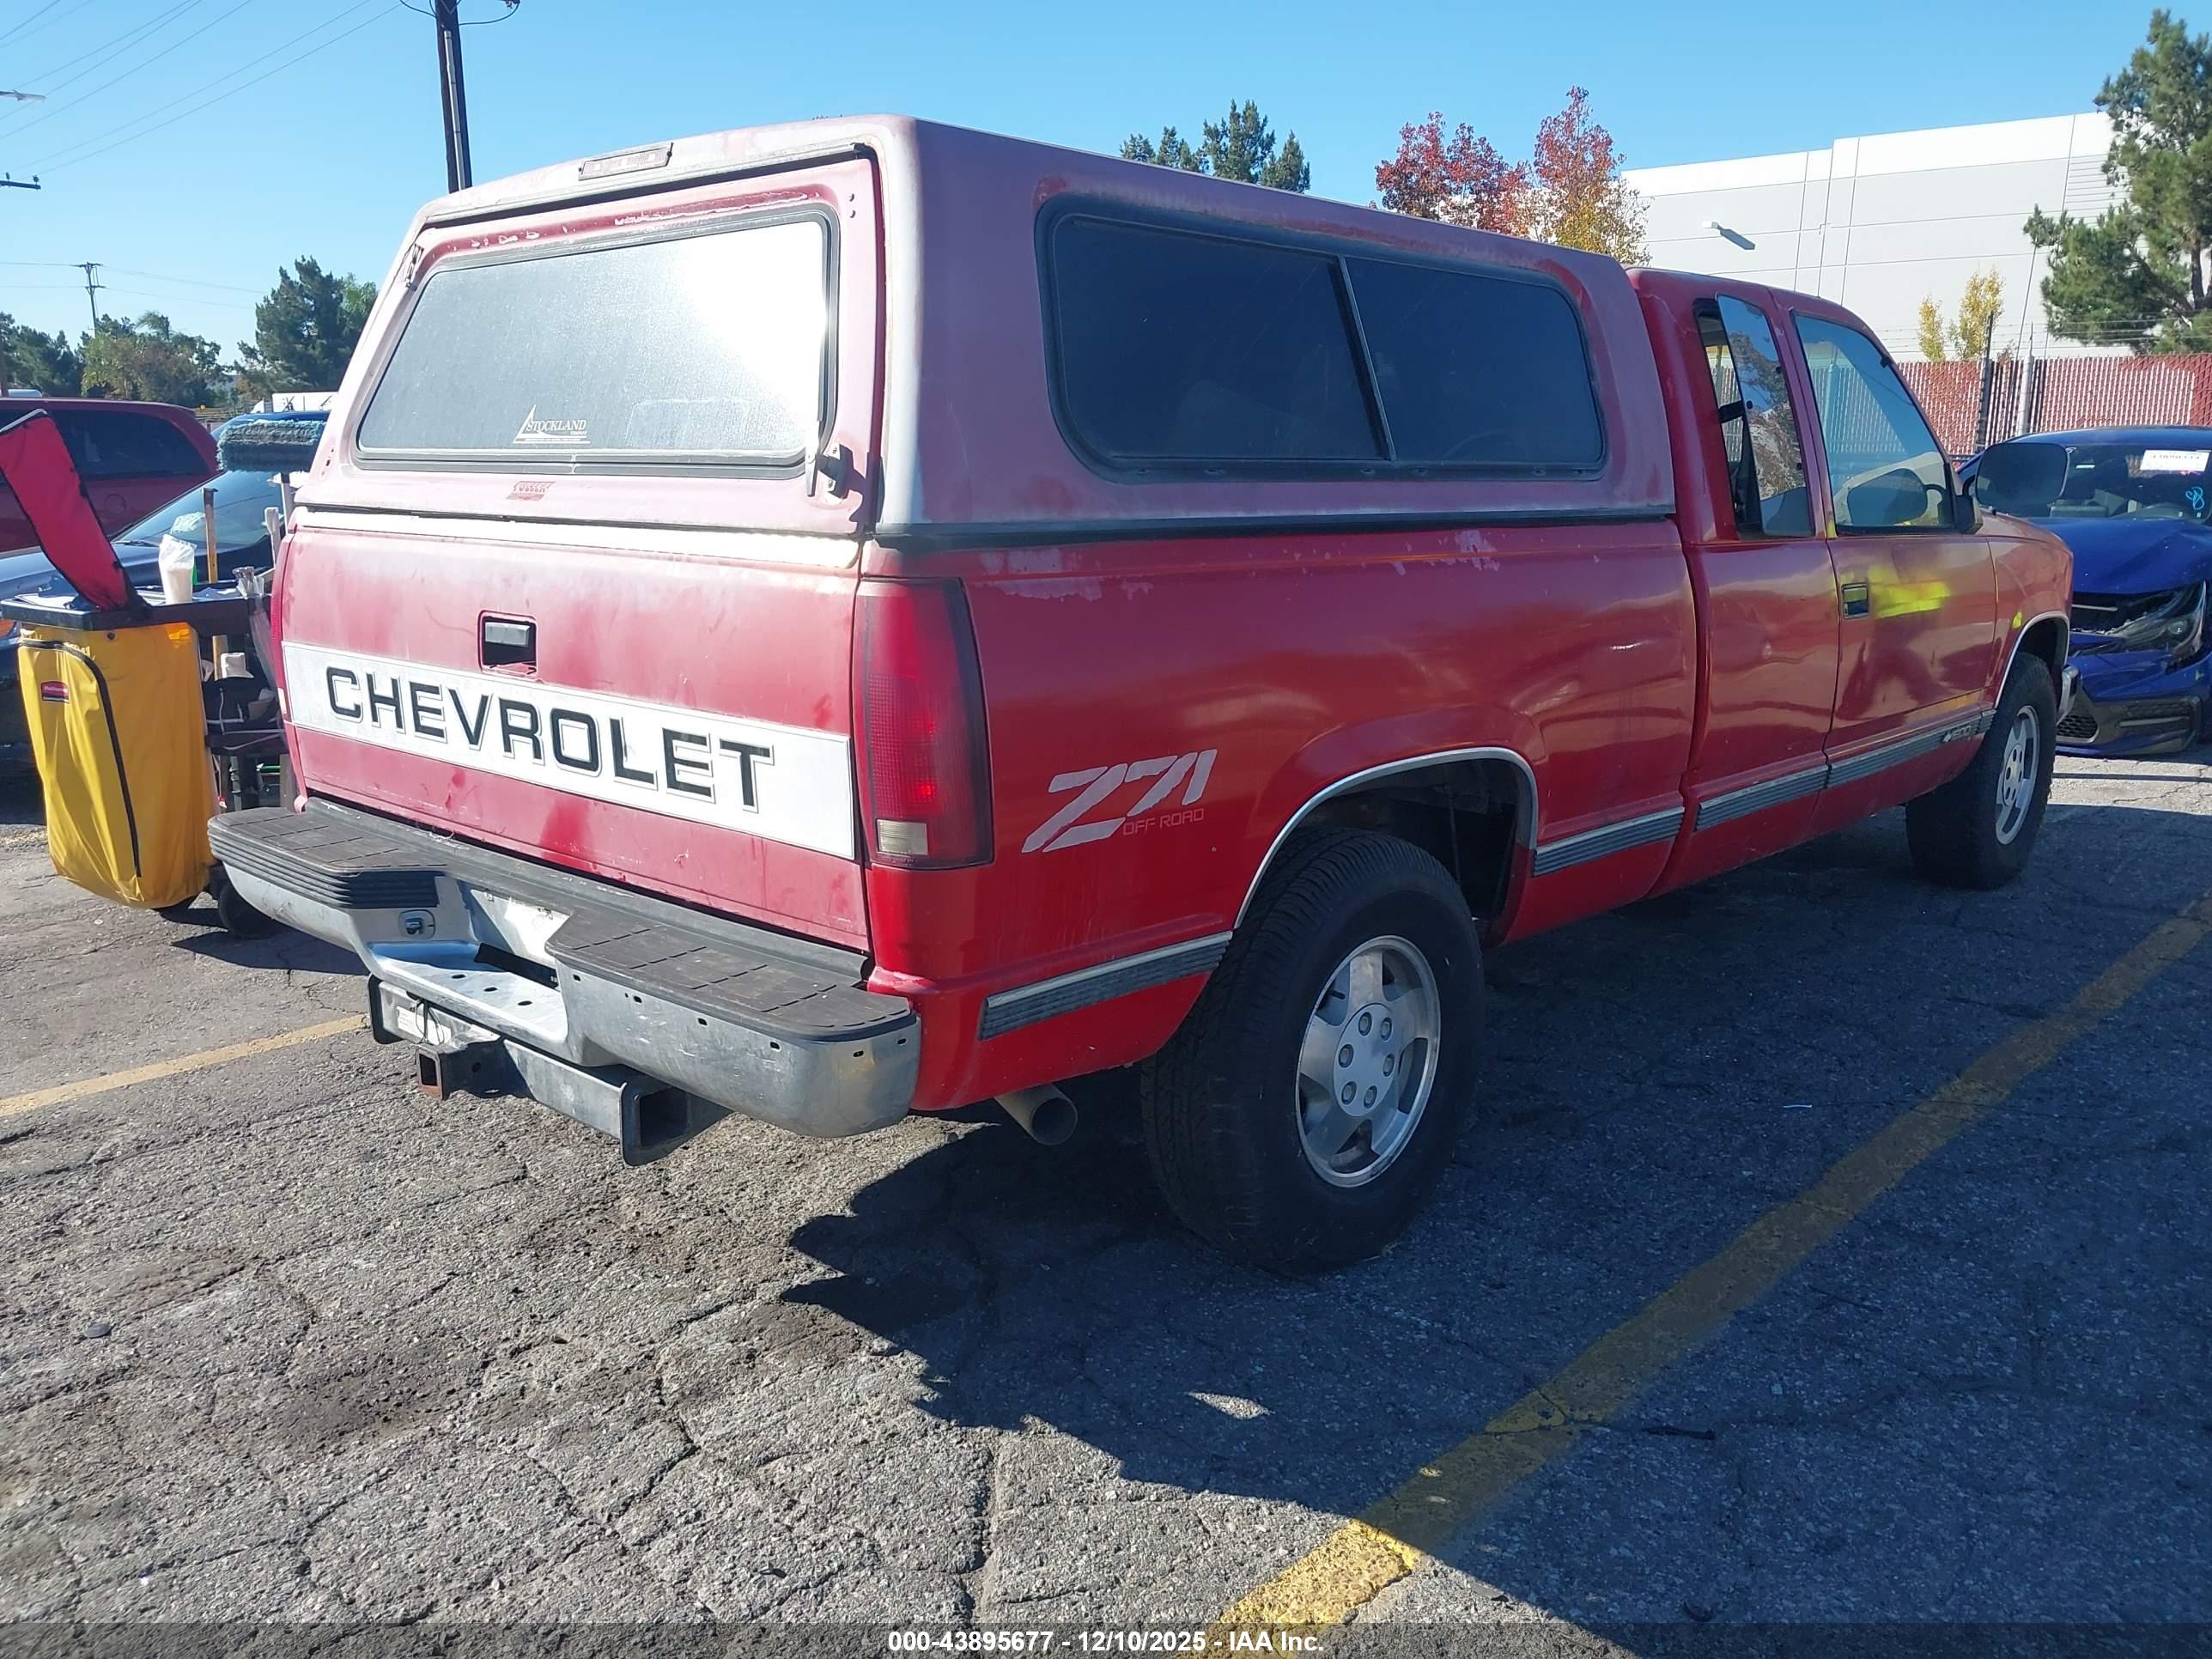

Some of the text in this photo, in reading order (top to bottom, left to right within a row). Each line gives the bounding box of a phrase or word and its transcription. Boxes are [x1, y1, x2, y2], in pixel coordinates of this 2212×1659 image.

[526, 420, 587, 431] STOCKLAND
[325, 665, 775, 812] CHEVROLET
[1021, 748, 1218, 854] Z71
[1122, 808, 1205, 836] OFF ROAD
